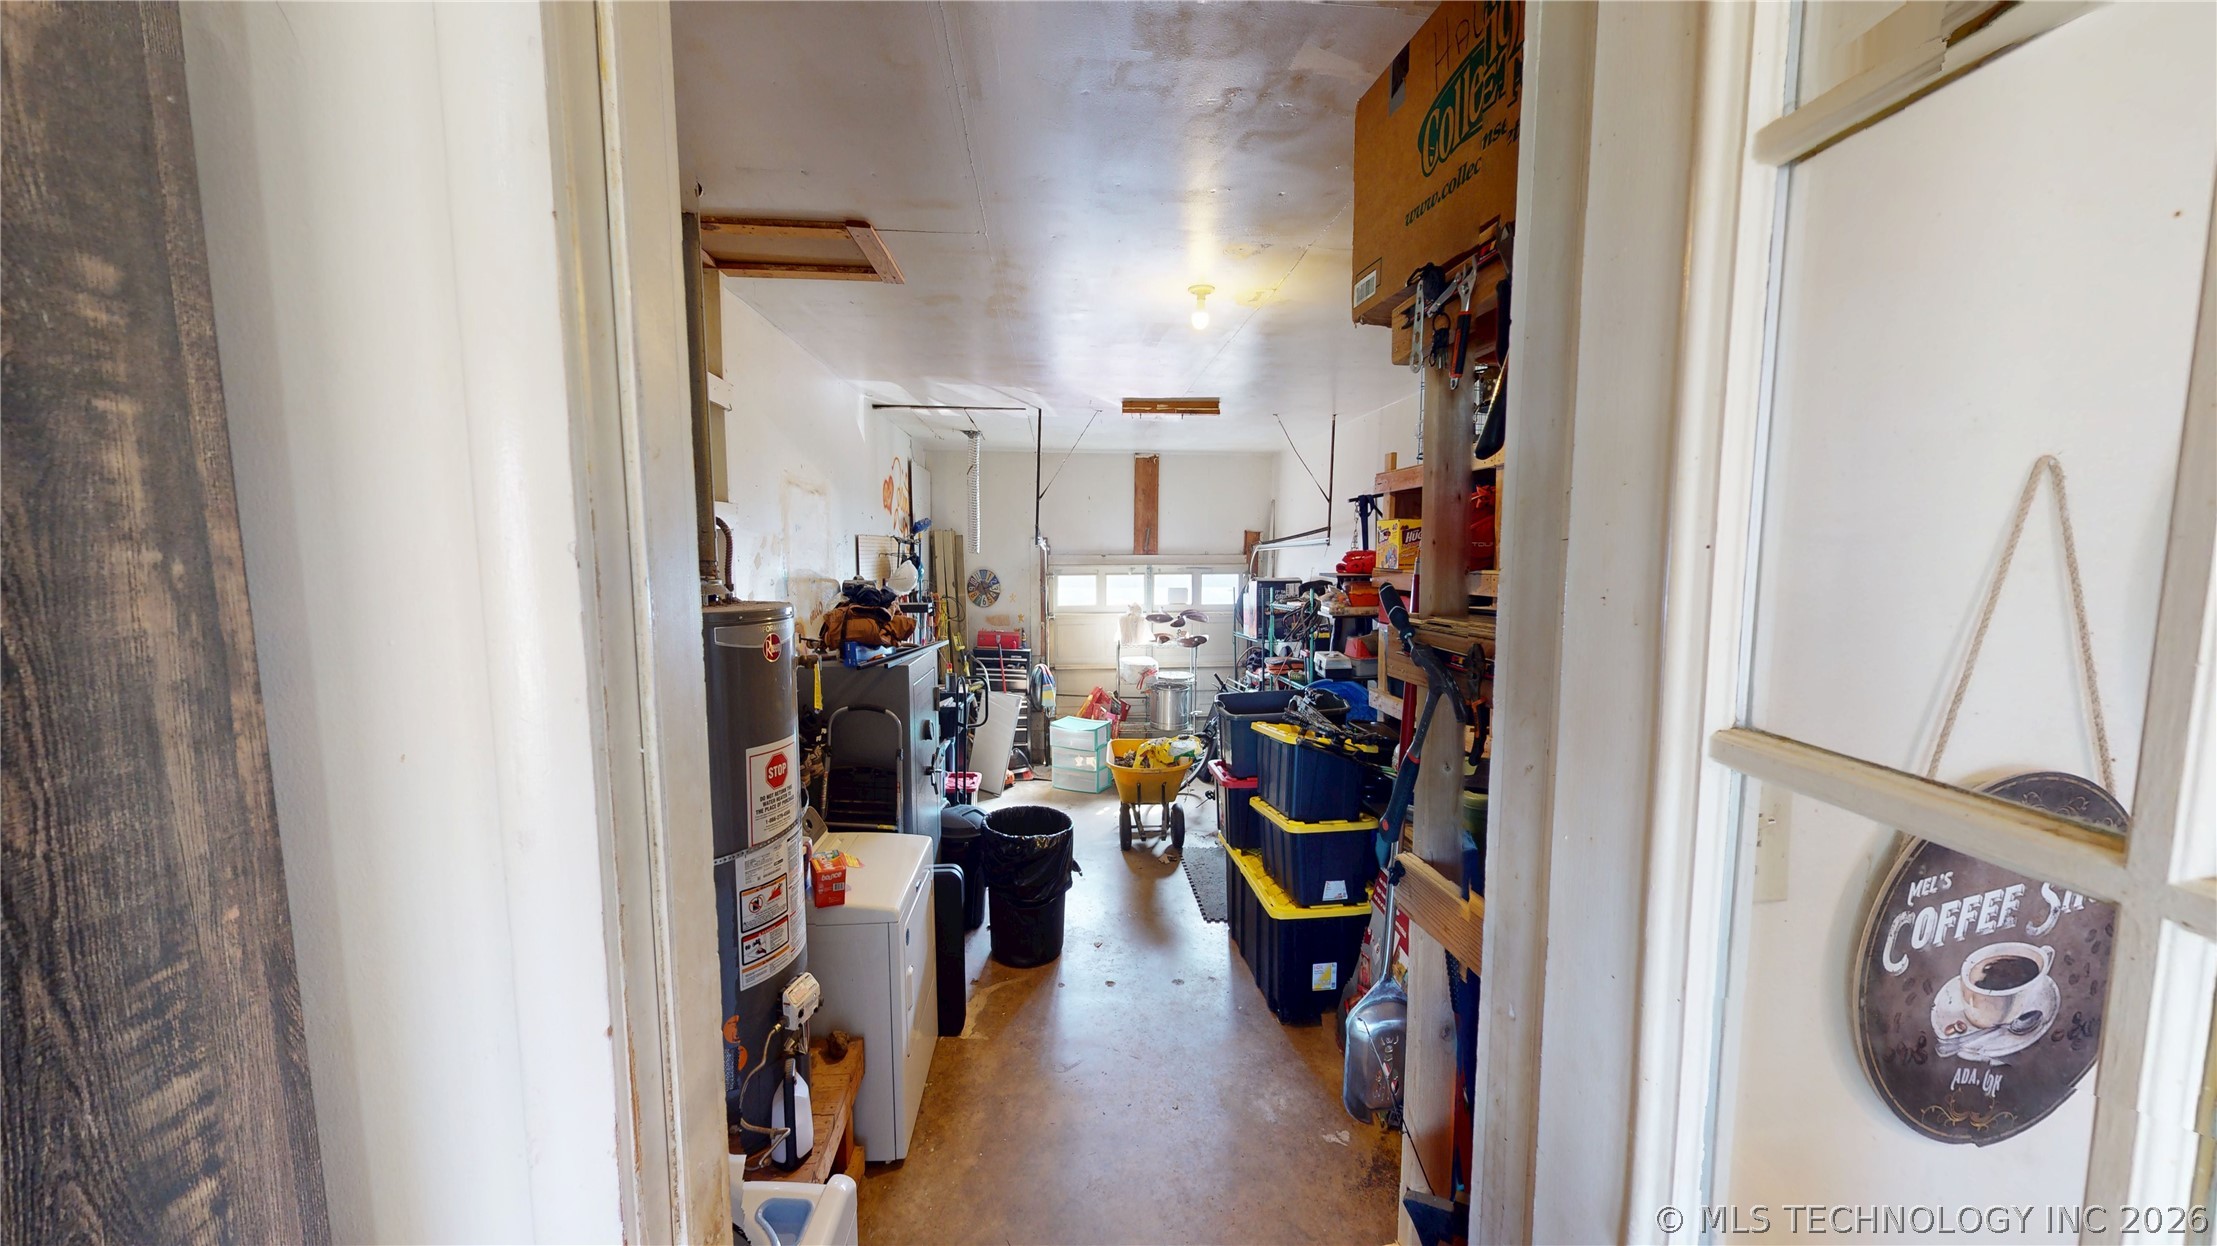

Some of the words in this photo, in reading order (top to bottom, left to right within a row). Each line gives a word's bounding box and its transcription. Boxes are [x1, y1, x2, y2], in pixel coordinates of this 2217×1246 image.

[768, 763, 787, 779] STOP
[1907, 871, 1954, 906] MEL'S
[1881, 883, 2025, 976] COFFEE
[1982, 1068, 2003, 1098] OK
